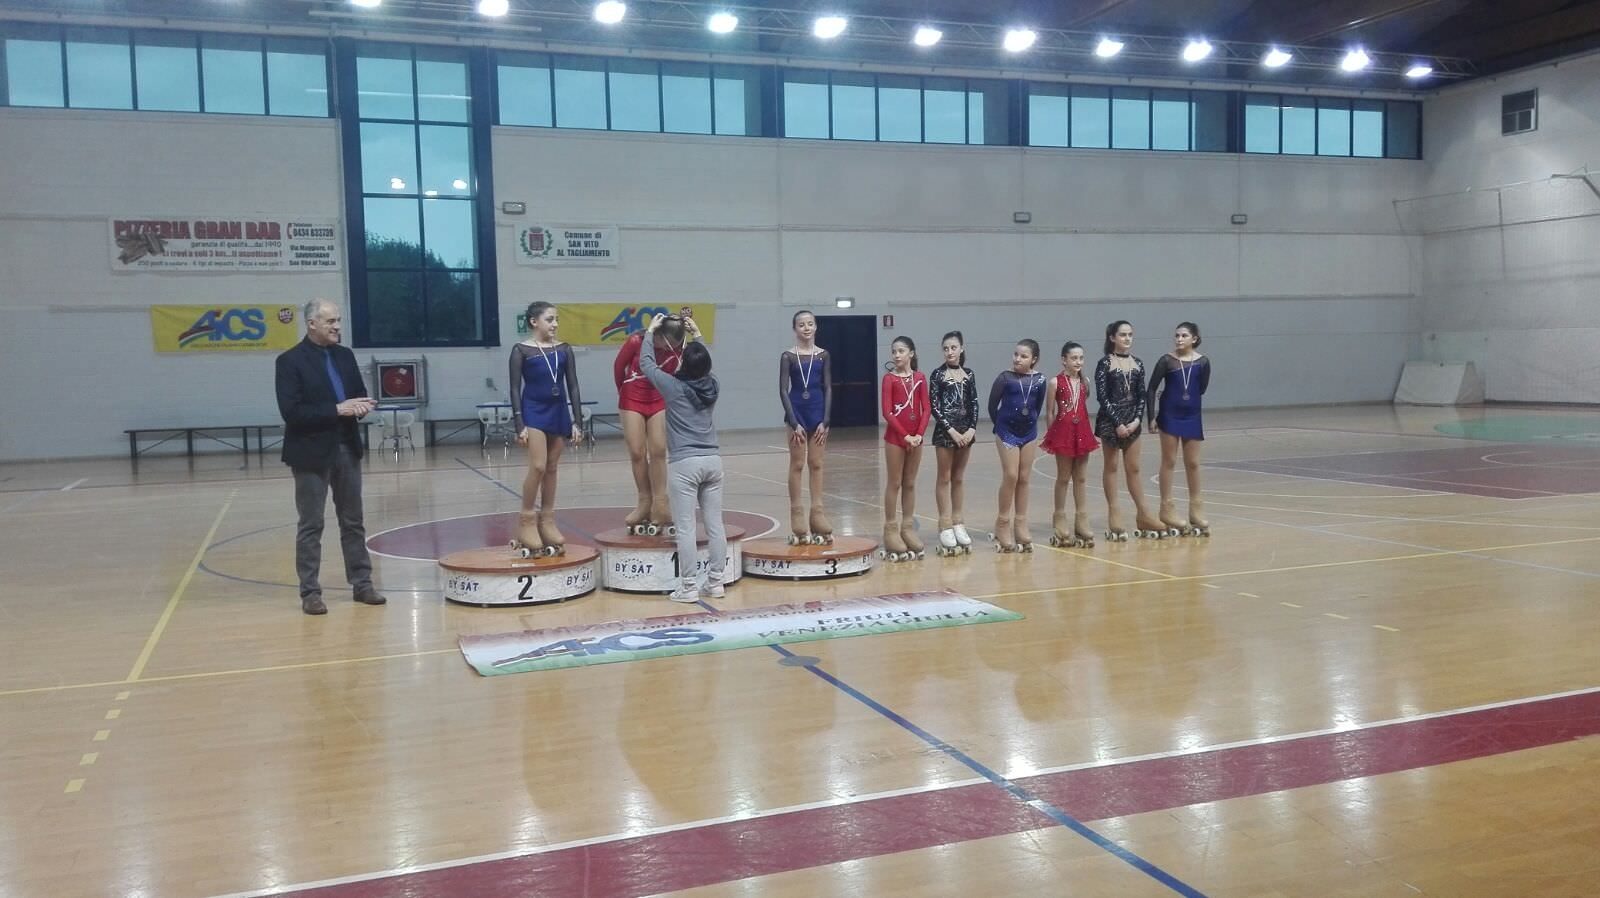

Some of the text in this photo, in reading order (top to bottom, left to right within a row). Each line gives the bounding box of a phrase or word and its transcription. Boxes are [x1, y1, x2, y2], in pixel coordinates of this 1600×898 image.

[113, 220, 281, 240] PIZZERIA GRAN BAR
[564, 231, 602, 239] Comune di
[264, 241, 282, 249] 1990
[568, 240, 599, 248] SAN VITO
[557, 249, 610, 257] AL TAGLIAMENTO
[616, 562, 653, 574] BY SAT
[770, 560, 792, 569] SAT
[566, 570, 593, 586] BY SAT
[460, 581, 479, 592] SAT
[817, 610, 912, 626] FRIULI
[758, 610, 990, 638] VENEZIA GIULIA
